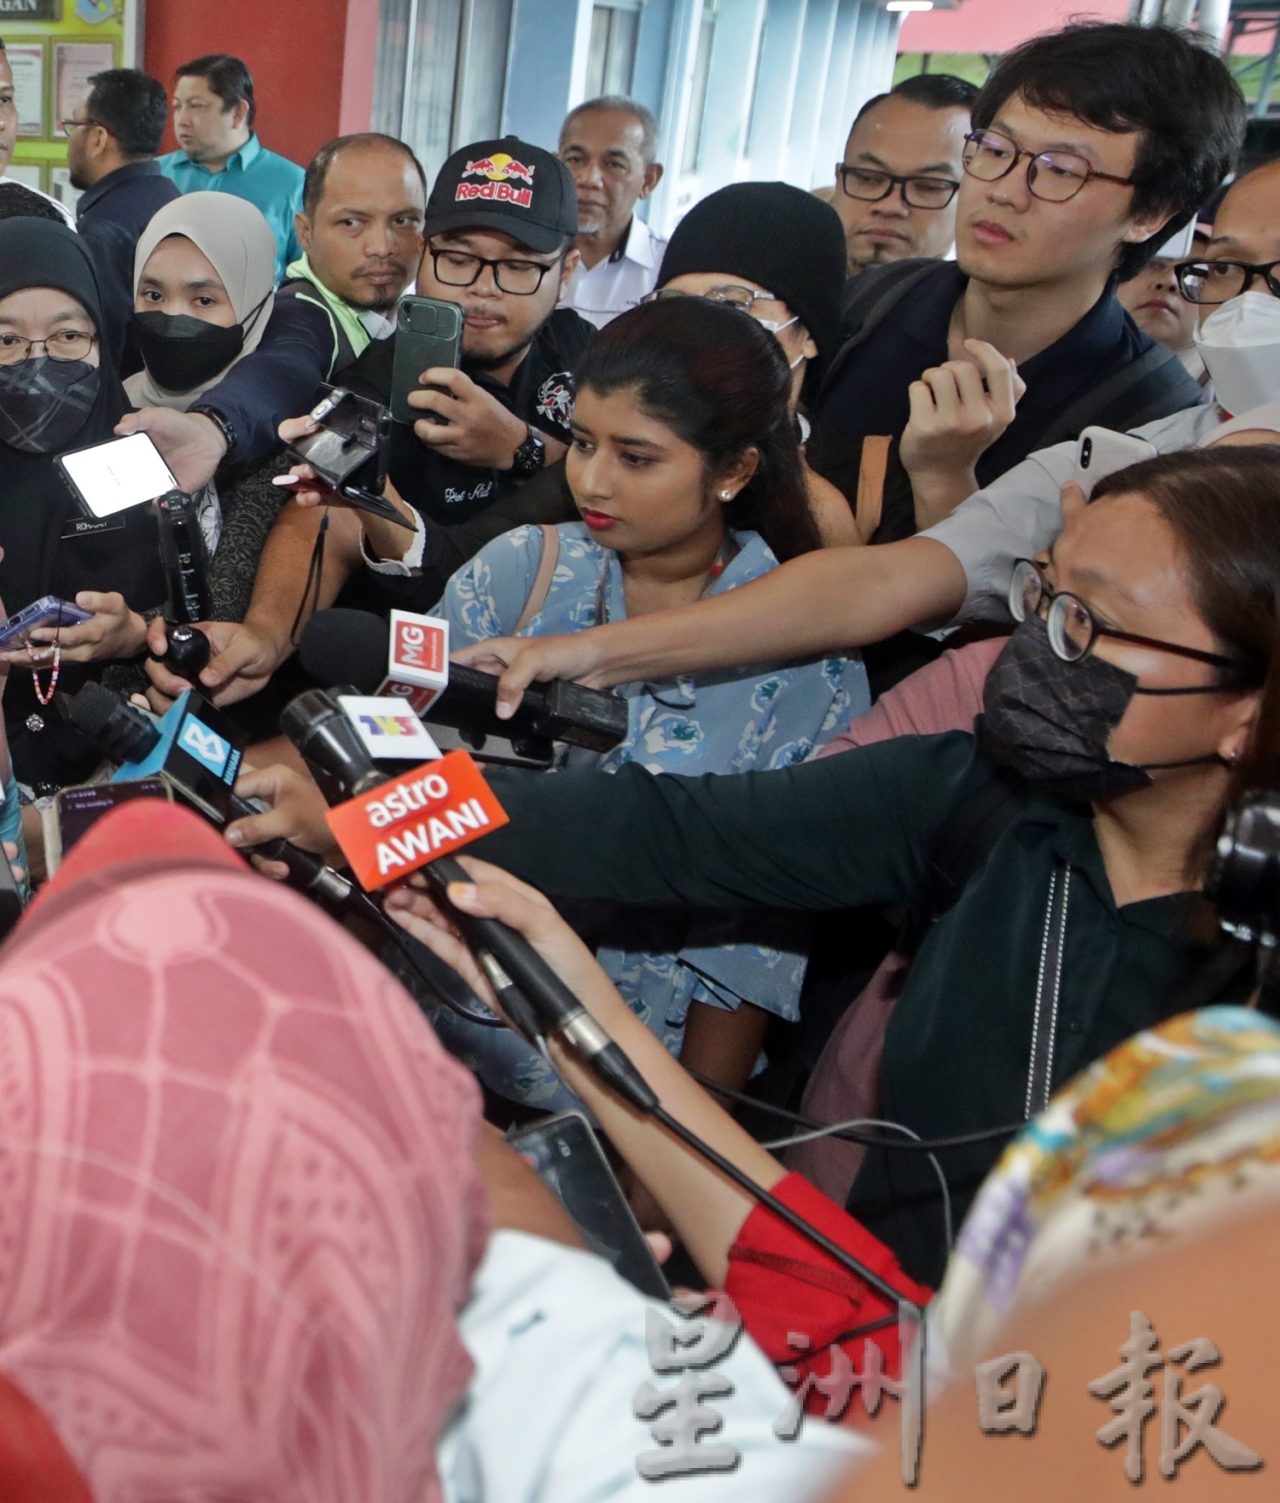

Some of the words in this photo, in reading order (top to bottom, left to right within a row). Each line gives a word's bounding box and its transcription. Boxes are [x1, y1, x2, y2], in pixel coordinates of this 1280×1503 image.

[455, 181, 496, 202] Red
[495, 182, 533, 209] Bull
[401, 626, 425, 666] MG
[358, 715, 418, 737] TV3
[364, 773, 449, 828] astro
[375, 797, 490, 876] AWANI
